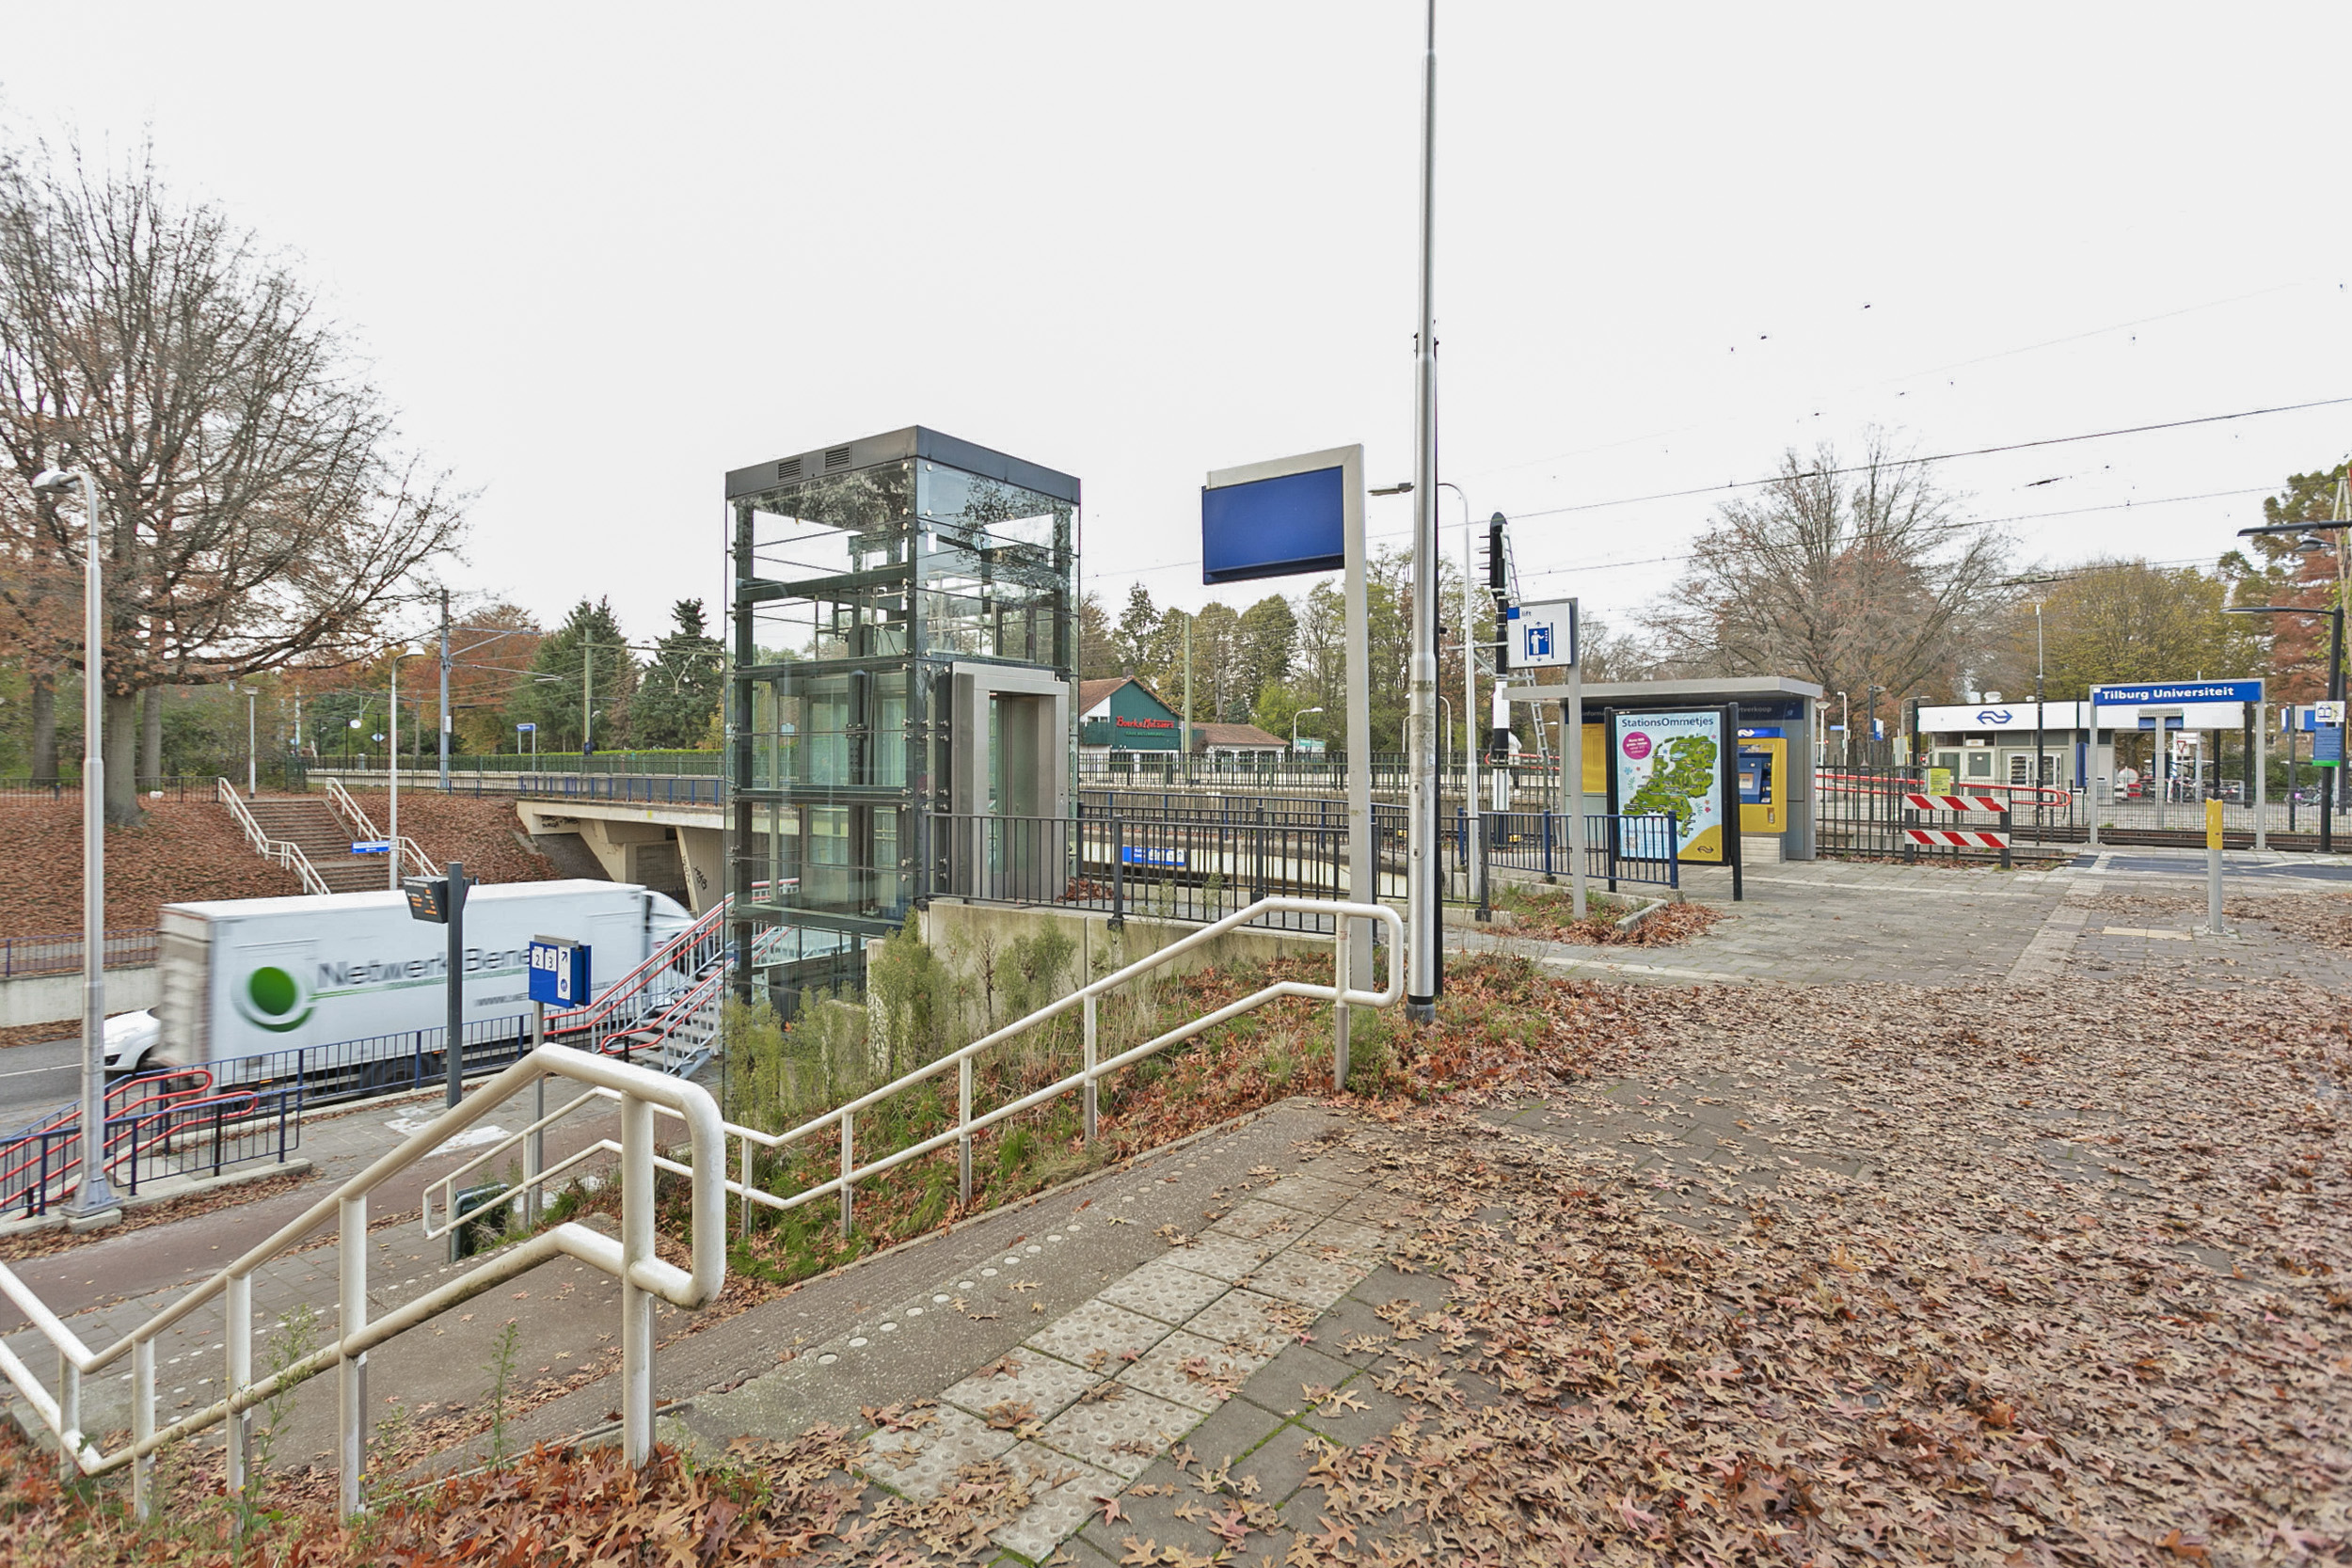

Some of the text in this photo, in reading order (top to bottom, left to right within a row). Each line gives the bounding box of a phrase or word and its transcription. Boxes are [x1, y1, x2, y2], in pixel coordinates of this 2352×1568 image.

[2103, 687, 2234, 701] Tilburg Universiteit
[1621, 718, 1714, 728] StationsOmmetjes
[535, 954, 553, 969] 2 3
